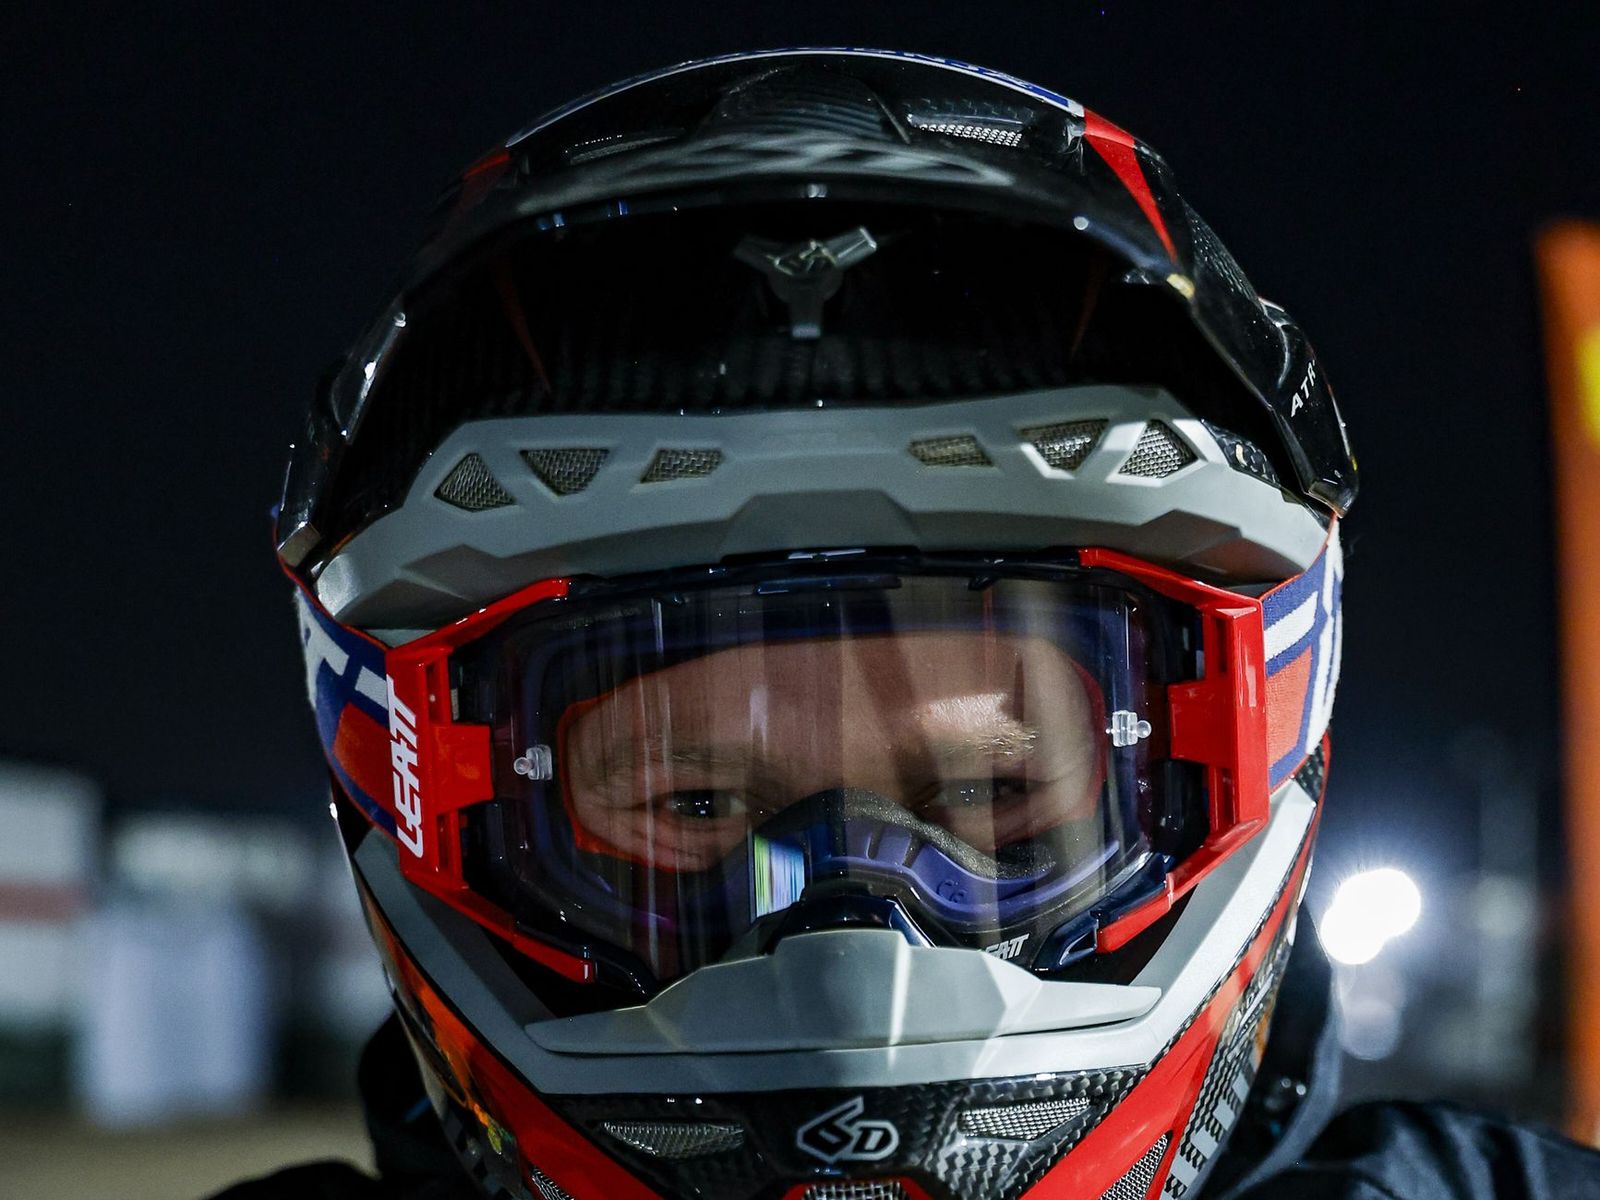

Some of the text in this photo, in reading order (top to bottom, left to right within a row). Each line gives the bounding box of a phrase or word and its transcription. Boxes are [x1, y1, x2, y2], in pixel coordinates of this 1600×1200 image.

[385, 673, 424, 859] LEATT
[985, 932, 1030, 960] EATT
[796, 1095, 900, 1164] 6D
